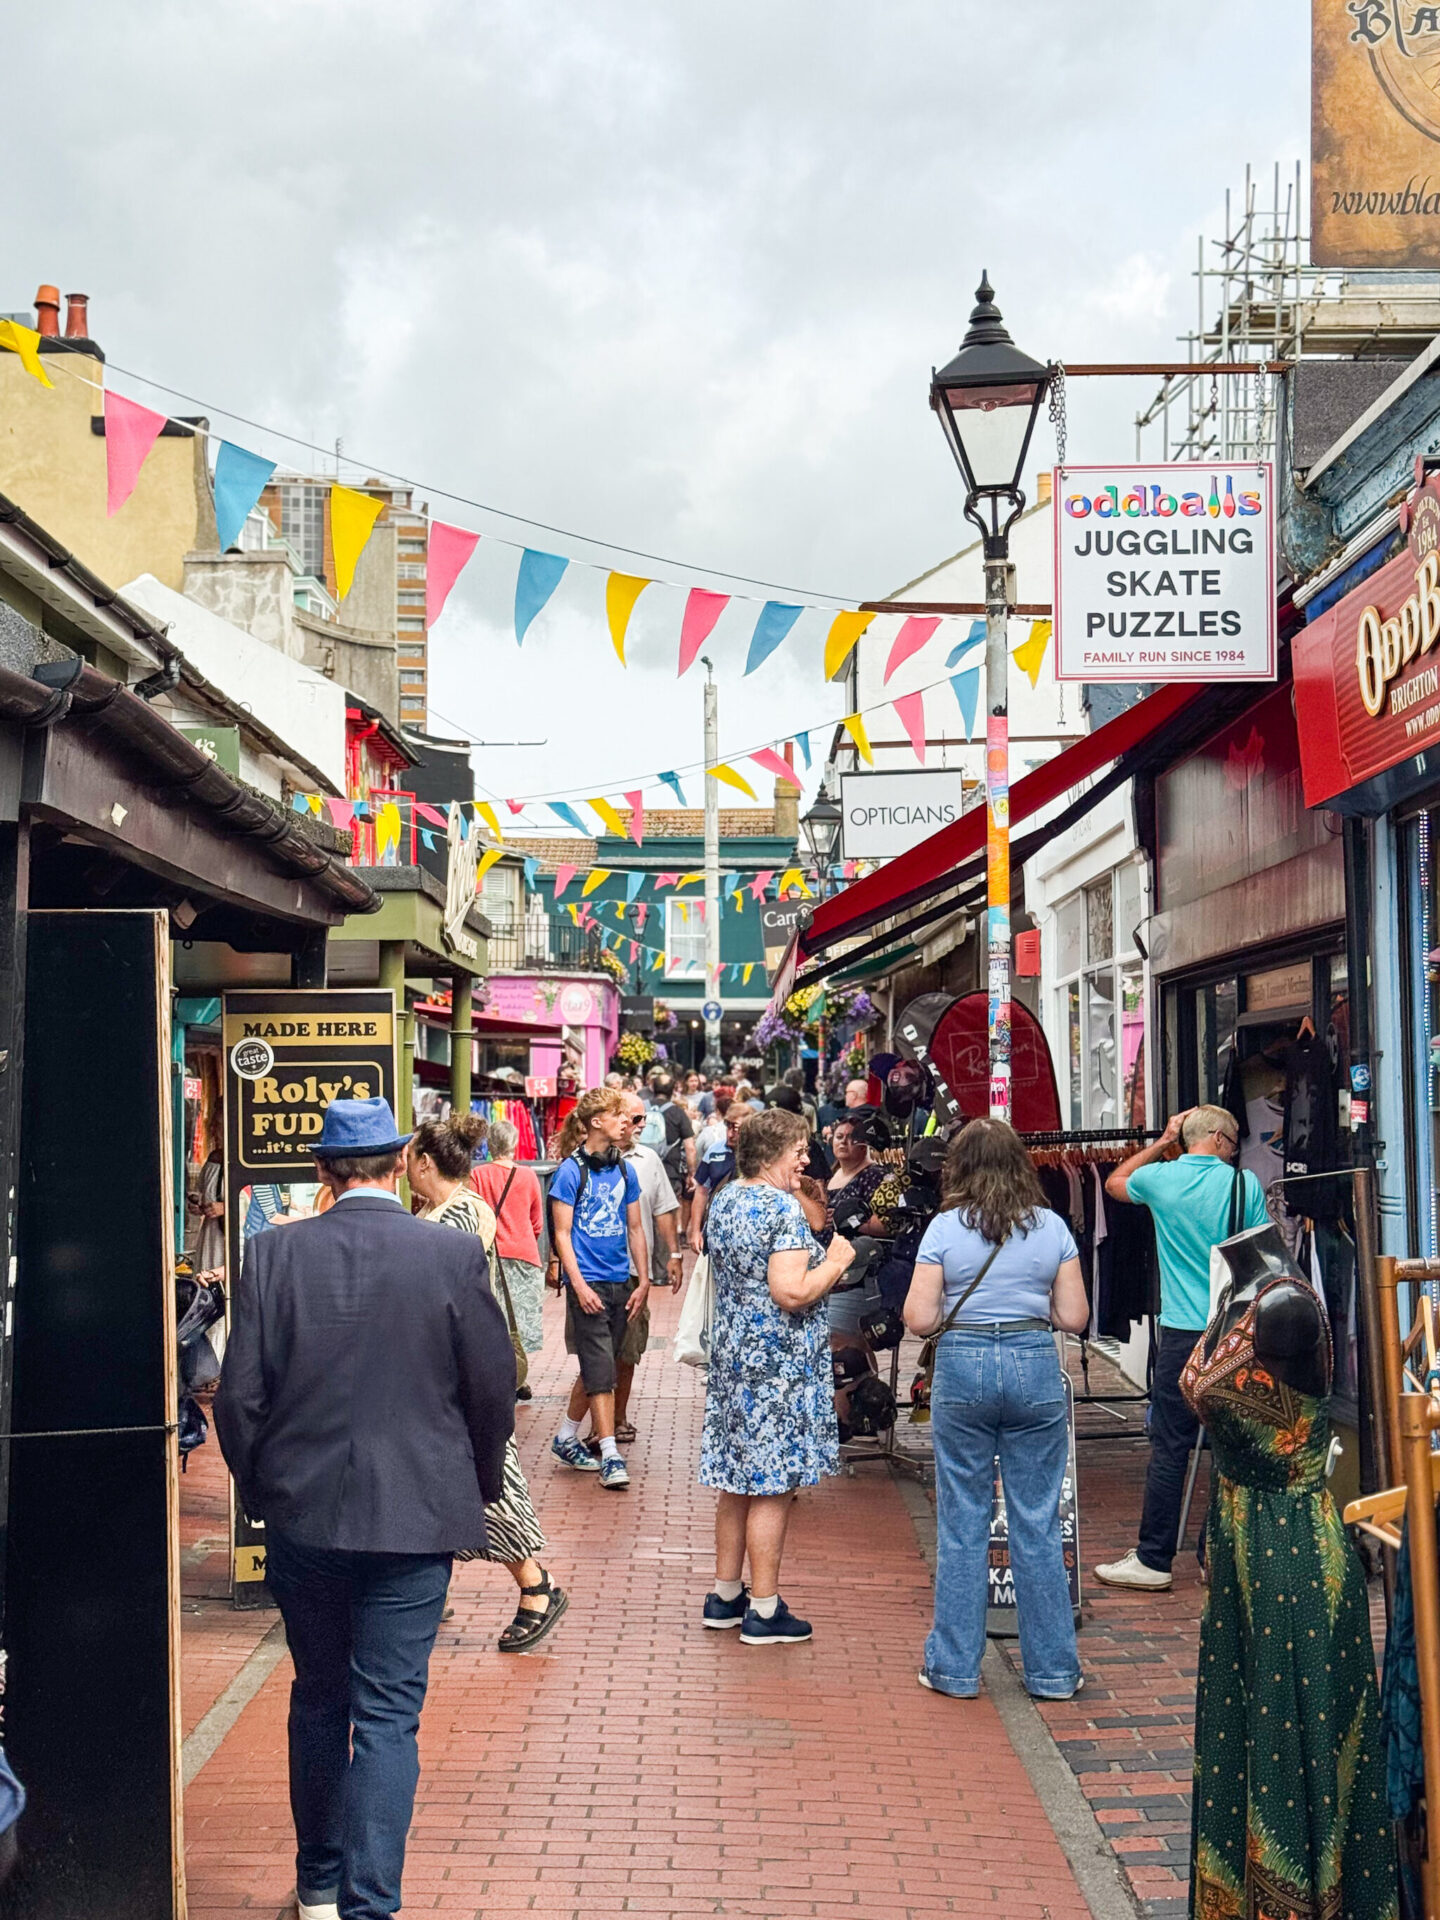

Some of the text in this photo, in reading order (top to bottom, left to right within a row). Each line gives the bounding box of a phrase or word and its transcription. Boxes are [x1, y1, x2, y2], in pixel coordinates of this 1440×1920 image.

[1332, 174, 1440, 216] www.bla
[1064, 475, 1262, 519] oddballs
[1074, 528, 1253, 557] JUGGLING
[1417, 523, 1438, 557] 1984
[1106, 569, 1221, 597] SKATE
[1086, 610, 1242, 639] PUZZLES
[1355, 550, 1440, 718] ODDB
[1084, 649, 1246, 664] FAMILY RUN SINCE 1984
[1390, 665, 1439, 717] BRIGHTON
[850, 804, 956, 827] OPTICIANS
[763, 910, 798, 928] Carr
[243, 1021, 377, 1038] MADE HERE
[237, 1053, 268, 1067] taste
[902, 1024, 960, 1115] OAKLE
[253, 1075, 370, 1109] Roly's
[252, 1113, 323, 1137] FUD
